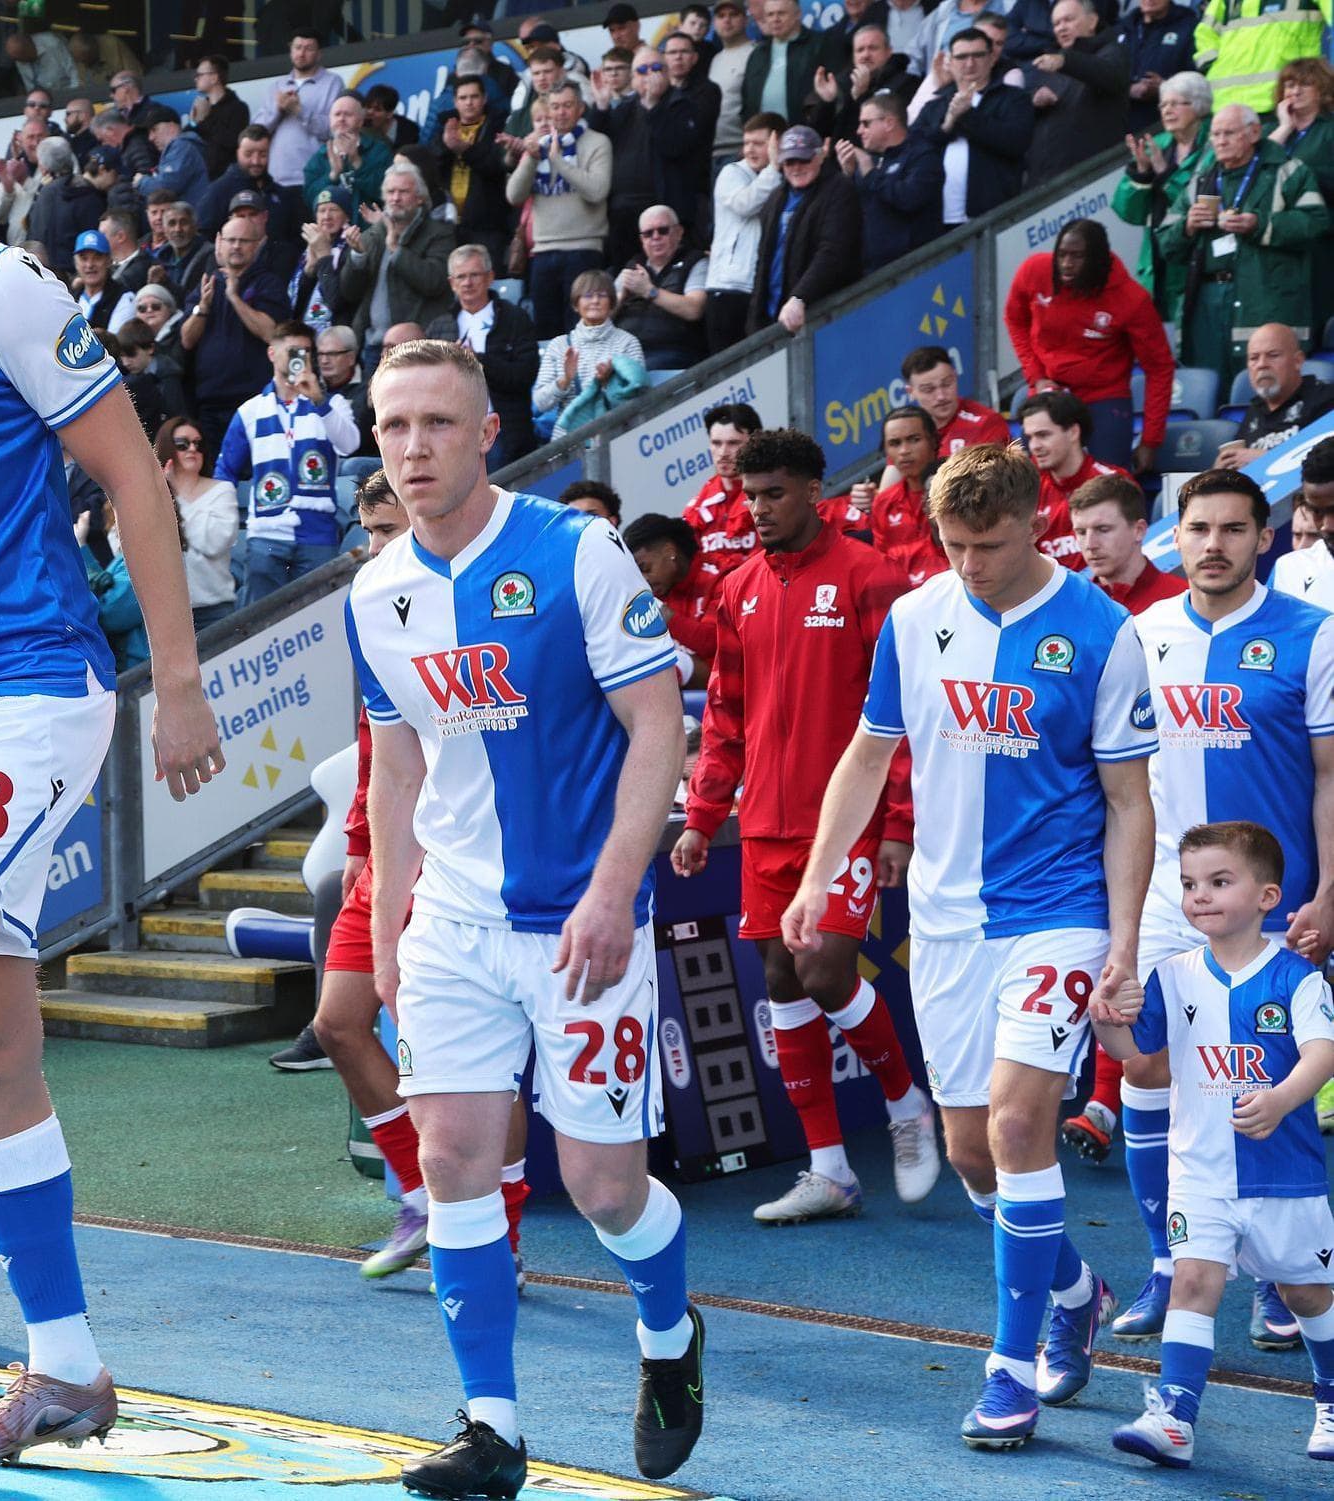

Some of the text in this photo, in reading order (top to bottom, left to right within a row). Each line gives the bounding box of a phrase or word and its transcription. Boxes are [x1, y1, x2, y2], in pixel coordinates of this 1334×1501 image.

[1039, 535, 1082, 560] 32R
[803, 615, 845, 628] 32Red
[229, 622, 325, 688] Hygiene
[410, 643, 527, 713] WR
[219, 673, 311, 741] leaning
[442, 718, 518, 738] OLICITORS
[940, 678, 1041, 738] WR
[1161, 684, 1251, 730] WR
[826, 855, 873, 899] 29
[1020, 965, 1094, 1025] 29
[563, 1015, 645, 1085] 28
[671, 1049, 683, 1078] EFL
[1196, 1044, 1273, 1082] WR
